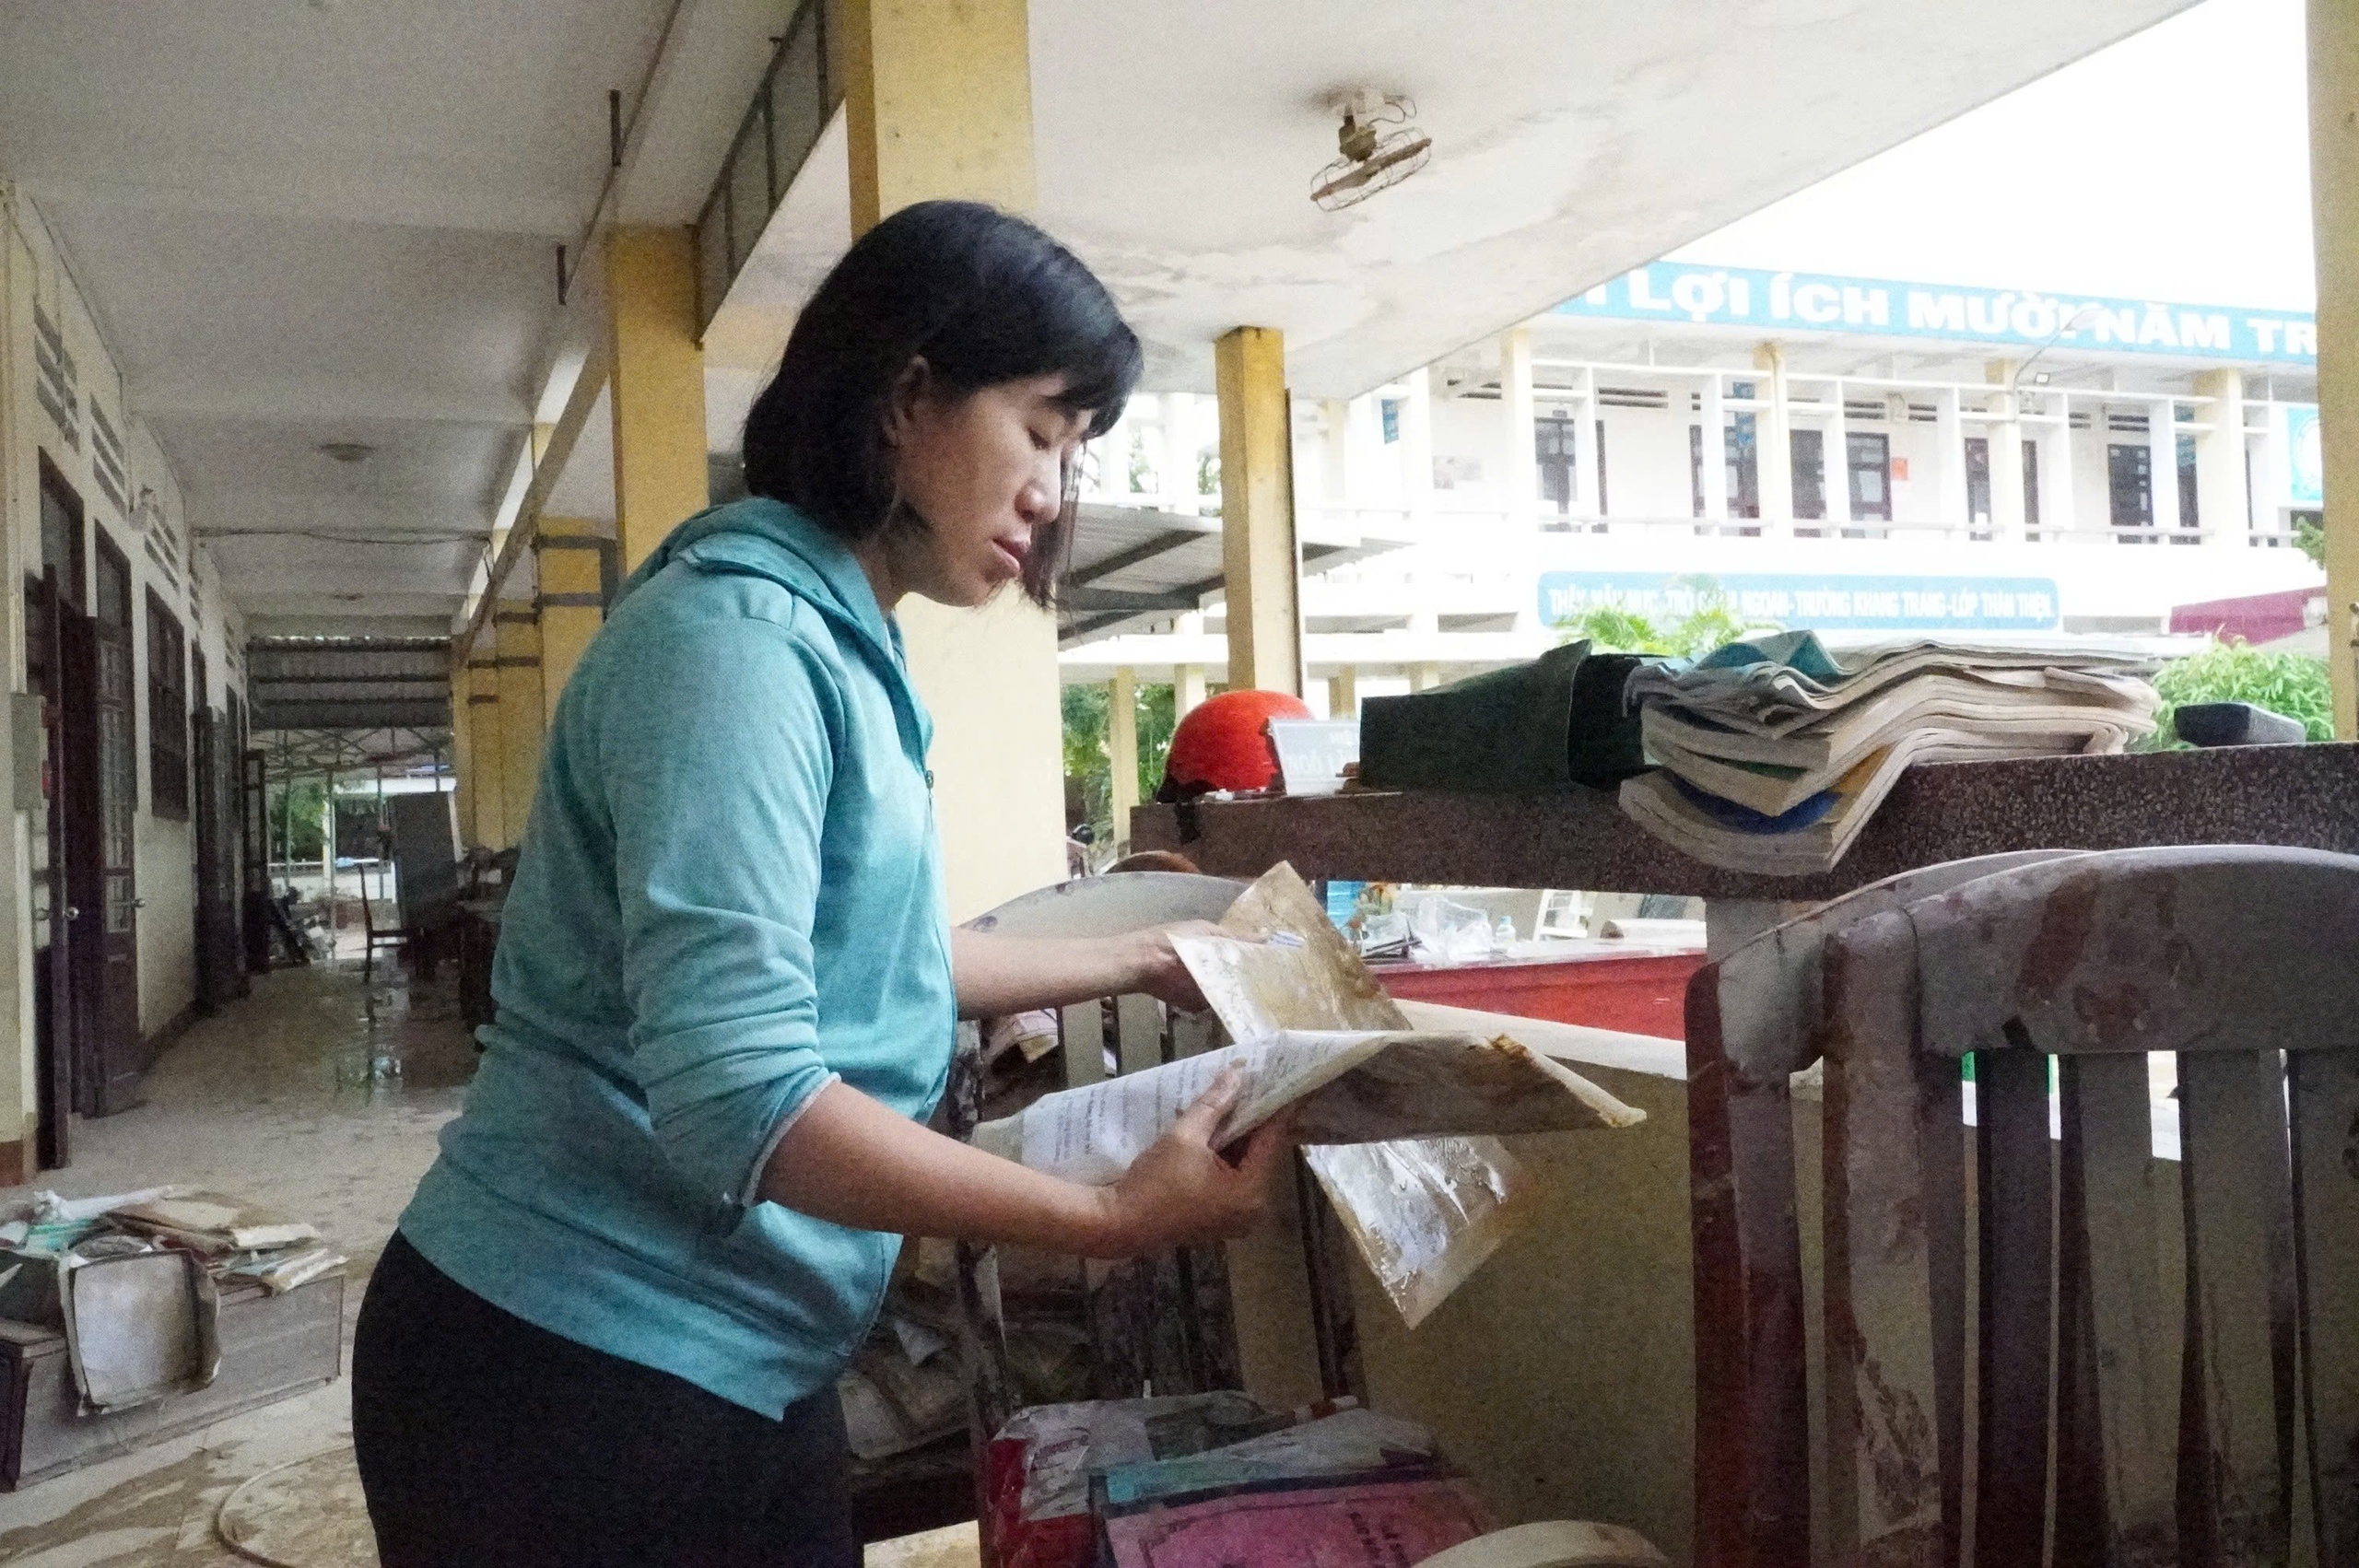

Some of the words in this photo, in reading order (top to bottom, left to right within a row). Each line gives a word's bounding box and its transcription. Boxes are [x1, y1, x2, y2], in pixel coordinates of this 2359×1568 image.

[1627, 268, 1751, 322] LỢI
[1769, 271, 1890, 326] ÍCH
[2095, 301, 2232, 349] NĂM
